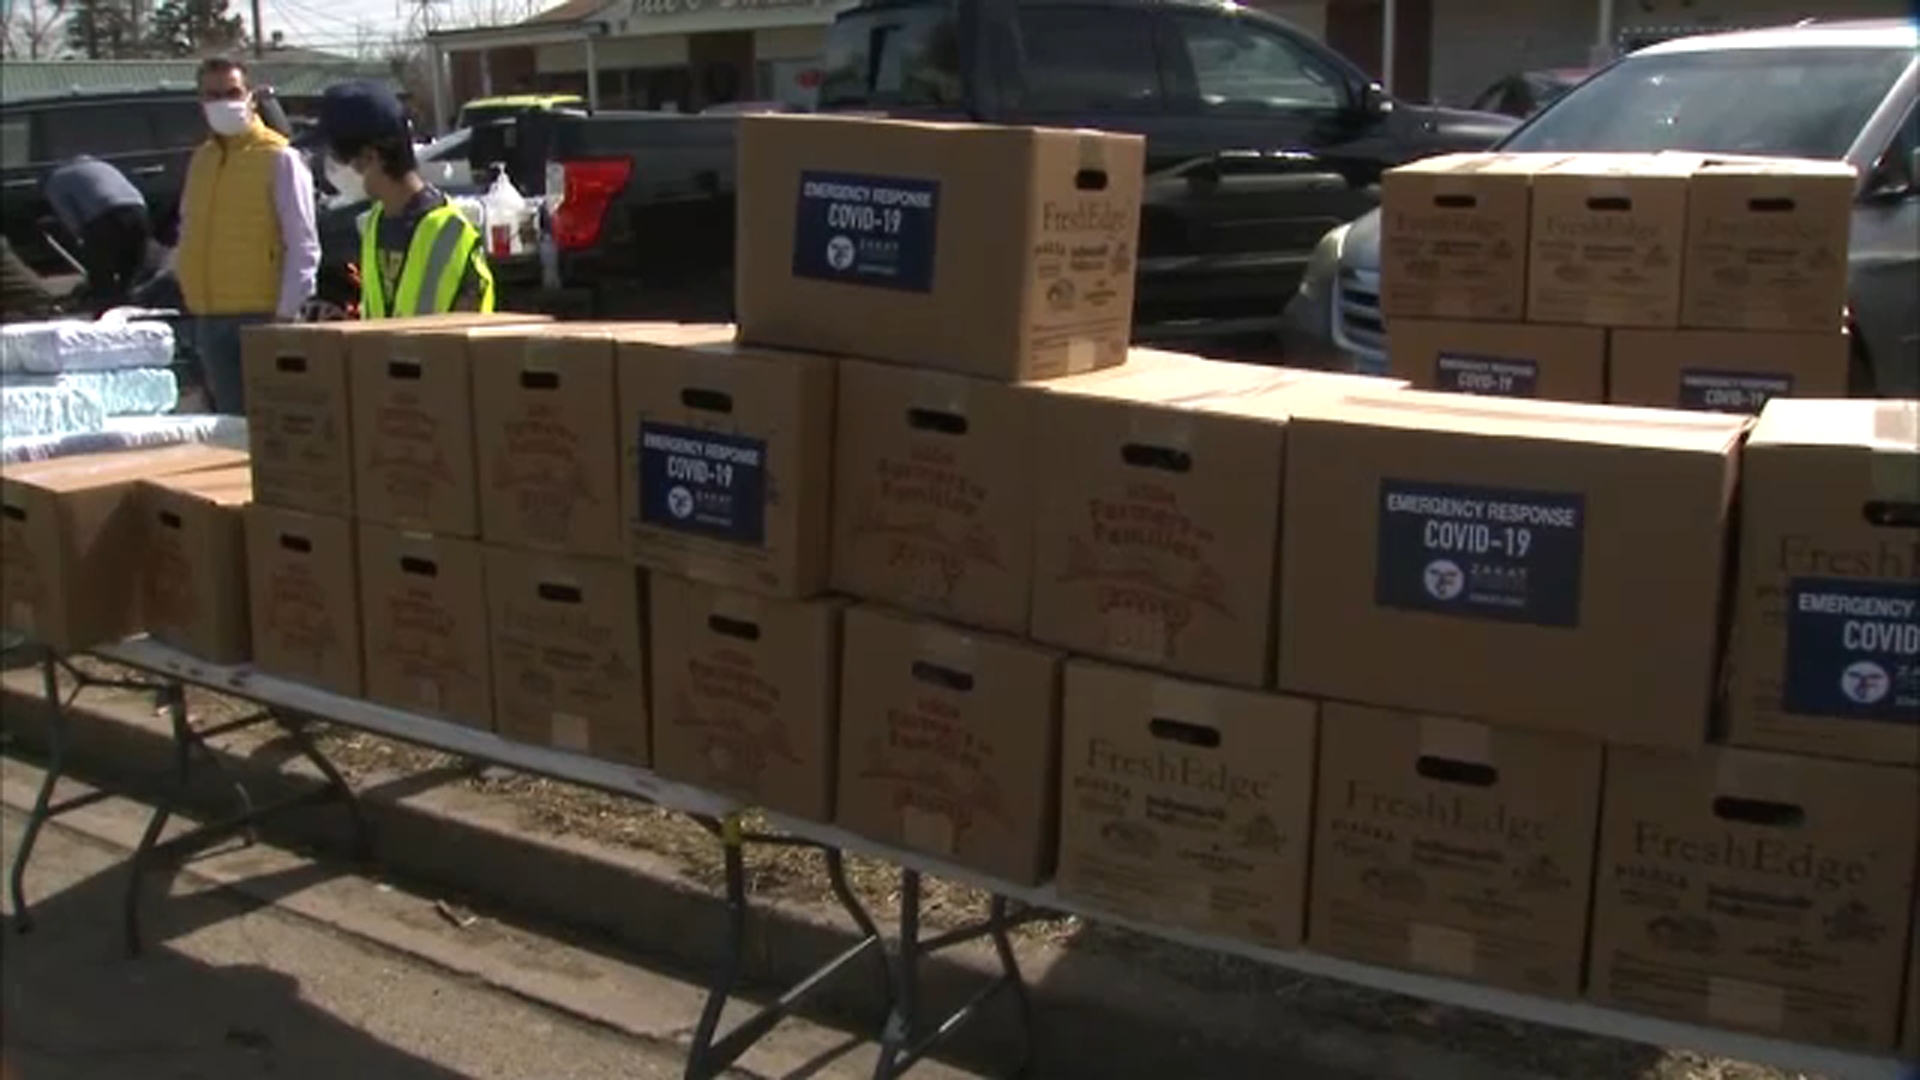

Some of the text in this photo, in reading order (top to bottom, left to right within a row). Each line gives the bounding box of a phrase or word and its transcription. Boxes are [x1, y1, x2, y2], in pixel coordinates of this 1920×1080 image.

[803, 181, 932, 208] EMERGENCY RESPONSE
[827, 203, 901, 233] COVID-19
[643, 432, 759, 466] EMERGENCY RESPONSE
[667, 455, 733, 487] COVID-19
[1387, 493, 1576, 527] EMERGENCY RESPONSE
[1424, 518, 1532, 558] COVID-19
[1797, 592, 1915, 618] EMERGENCY
[1087, 736, 1272, 804] FreshEdge
[1346, 778, 1549, 847] FreshEdge
[1632, 817, 1868, 892] FreshEdge
